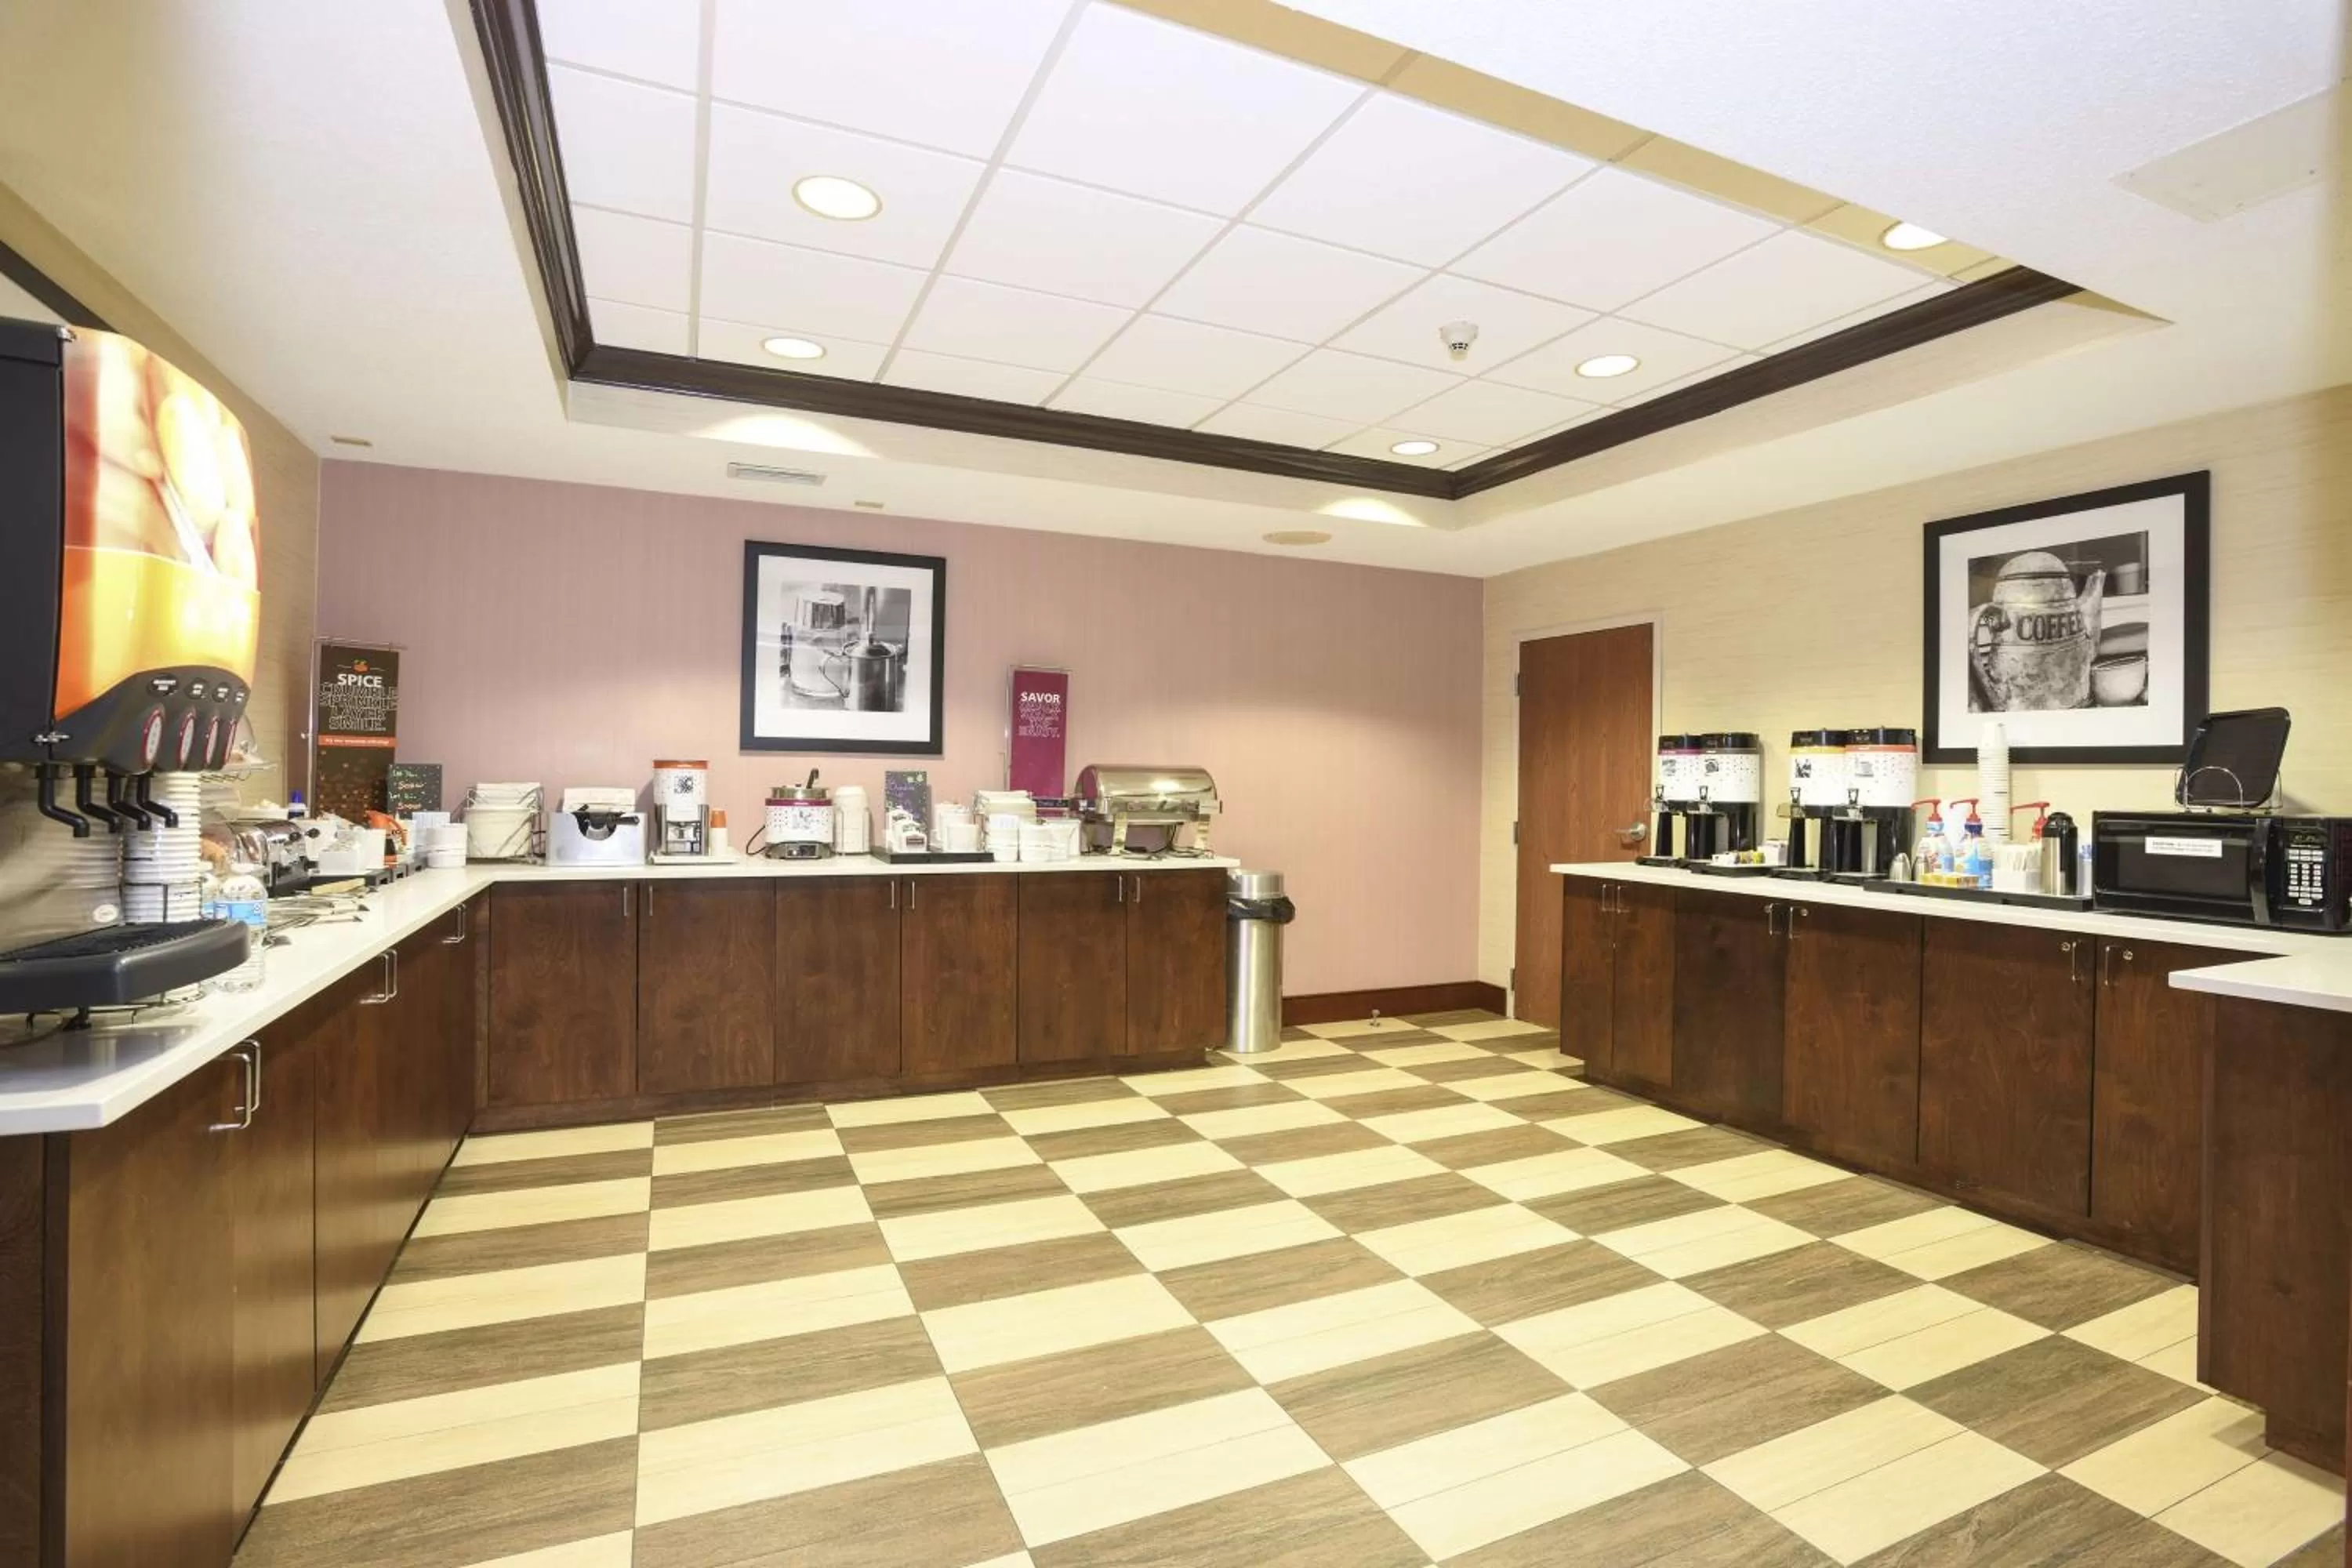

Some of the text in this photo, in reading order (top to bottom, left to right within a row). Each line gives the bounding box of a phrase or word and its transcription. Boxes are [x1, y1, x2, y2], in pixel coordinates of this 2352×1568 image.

[2016, 611, 2085, 641] COFFEE
[338, 674, 383, 688] SPICE
[1021, 691, 1061, 704] SAVOR
